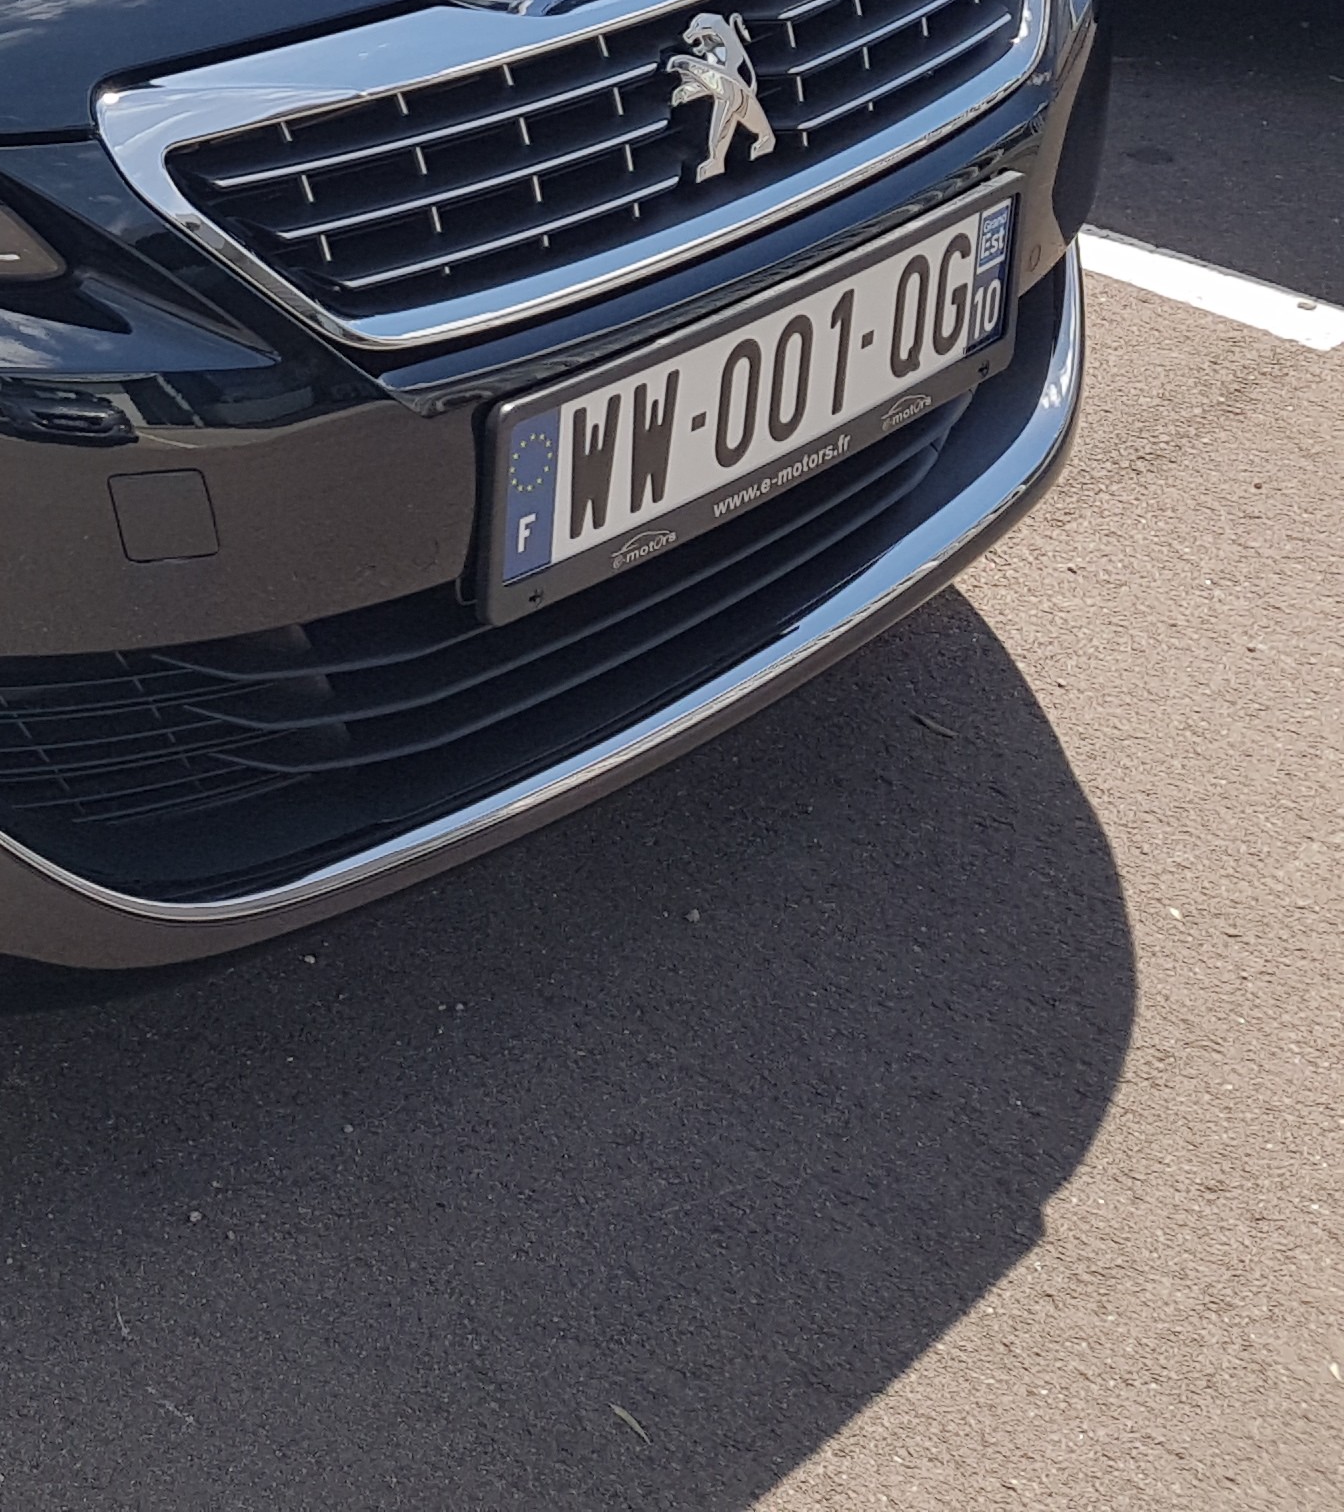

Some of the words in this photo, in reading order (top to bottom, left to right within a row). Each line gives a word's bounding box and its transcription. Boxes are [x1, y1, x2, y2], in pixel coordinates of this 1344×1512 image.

[981, 226, 1004, 259] Est
[973, 279, 1002, 339] 10
[570, 232, 972, 540] WW-001-QG
[713, 433, 852, 518] www.e-motors.fr
[517, 512, 537, 554] F
